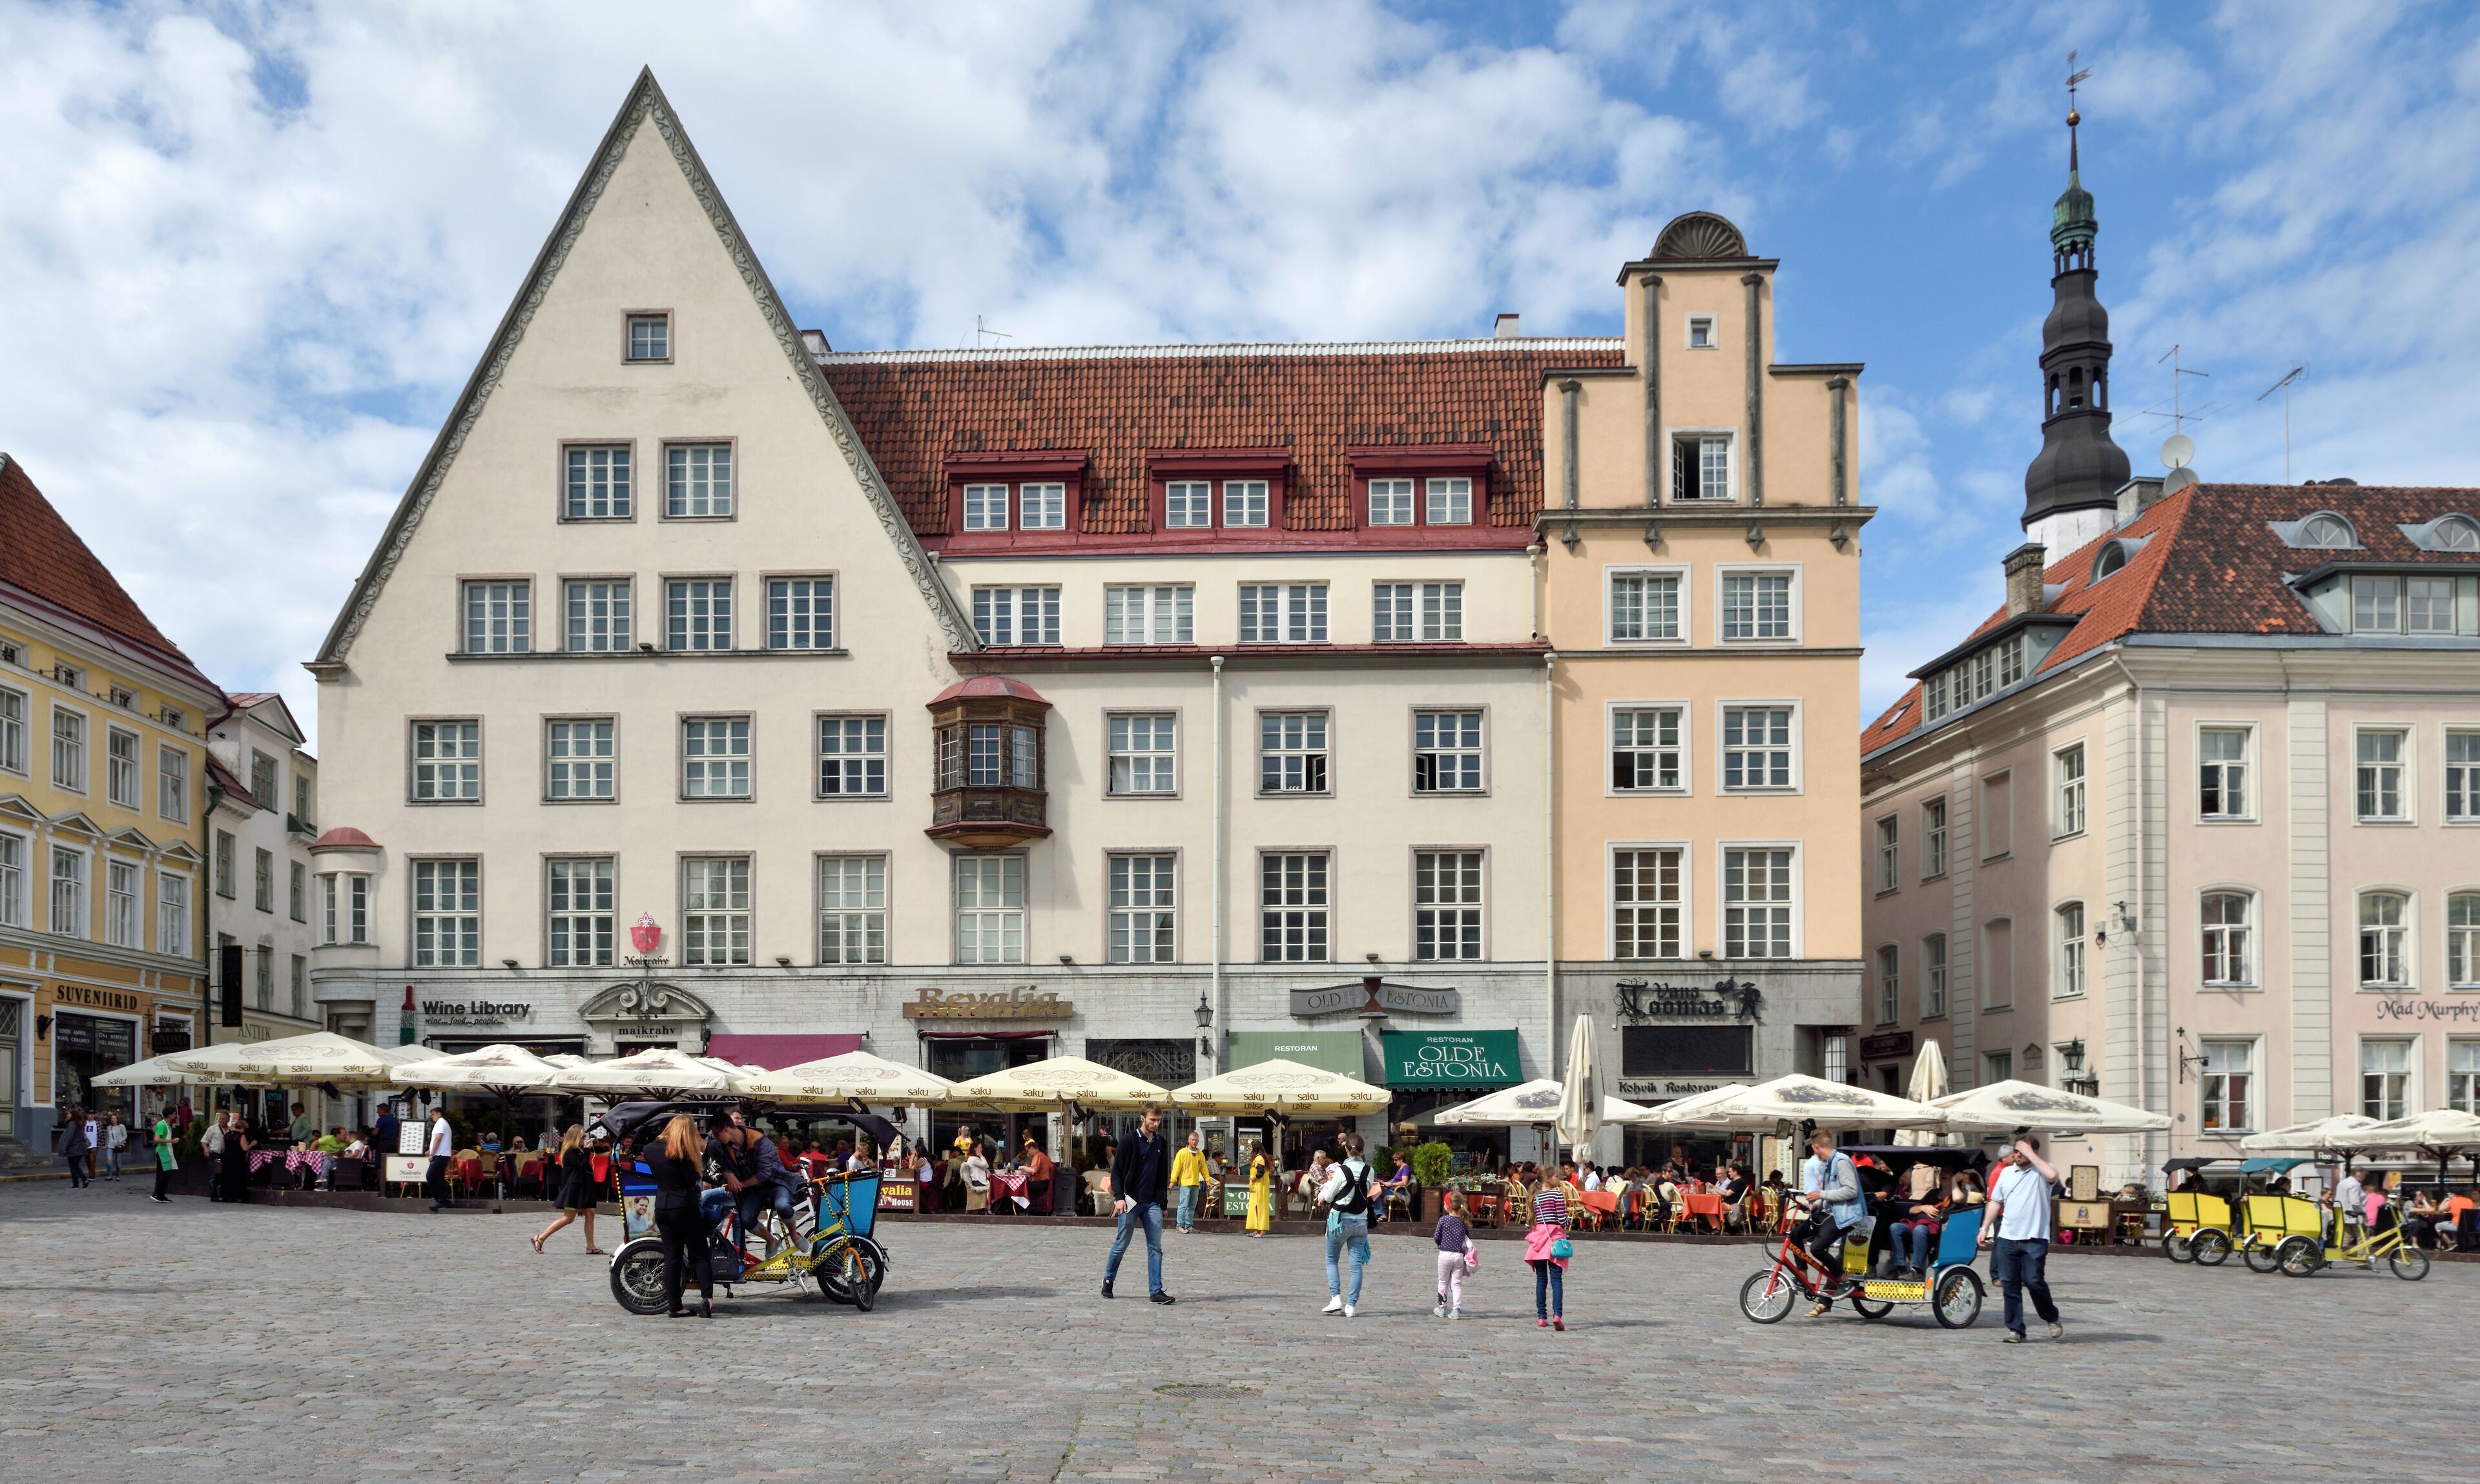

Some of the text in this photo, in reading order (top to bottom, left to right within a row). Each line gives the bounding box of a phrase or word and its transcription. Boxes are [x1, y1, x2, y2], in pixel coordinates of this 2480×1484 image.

[623, 956, 670, 966] Maikrahv
[1653, 982, 1699, 998] Vana
[57, 985, 138, 1010] SUVENIIRID
[915, 985, 1060, 1009] Revalia
[1308, 990, 1449, 1009] OLDE ESTONIA
[422, 1001, 531, 1017] Wine Library
[2377, 1000, 2414, 1020] Mad
[450, 1016, 473, 1025] food...
[473, 1016, 504, 1025] people...
[238, 1024, 271, 1041] ANTIIK
[619, 1025, 676, 1035] maikrahv
[1418, 1046, 1486, 1062] OLDE
[238, 1063, 260, 1071] saku
[1403, 1062, 1508, 1077] ESTONIA
[750, 1084, 771, 1093] saku
[802, 1086, 823, 1095] saku
[855, 1086, 876, 1095] saku
[907, 1087, 929, 1097] saku
[970, 1087, 991, 1095] saku
[1618, 1081, 1658, 1095] Kohvik
[1023, 1089, 1044, 1098] saku
[1077, 1089, 1097, 1098] saku
[1130, 1089, 1150, 1098] saku
[1190, 1091, 1212, 1100] saku
[1243, 1093, 1265, 1101] saku
[1297, 1092, 1319, 1100] saku
[1350, 1092, 1372, 1100] saku
[892, 1198, 913, 1206] HOUSE
[816, 1230, 827, 1239] TAXI
[1788, 1243, 1801, 1254] ECO
